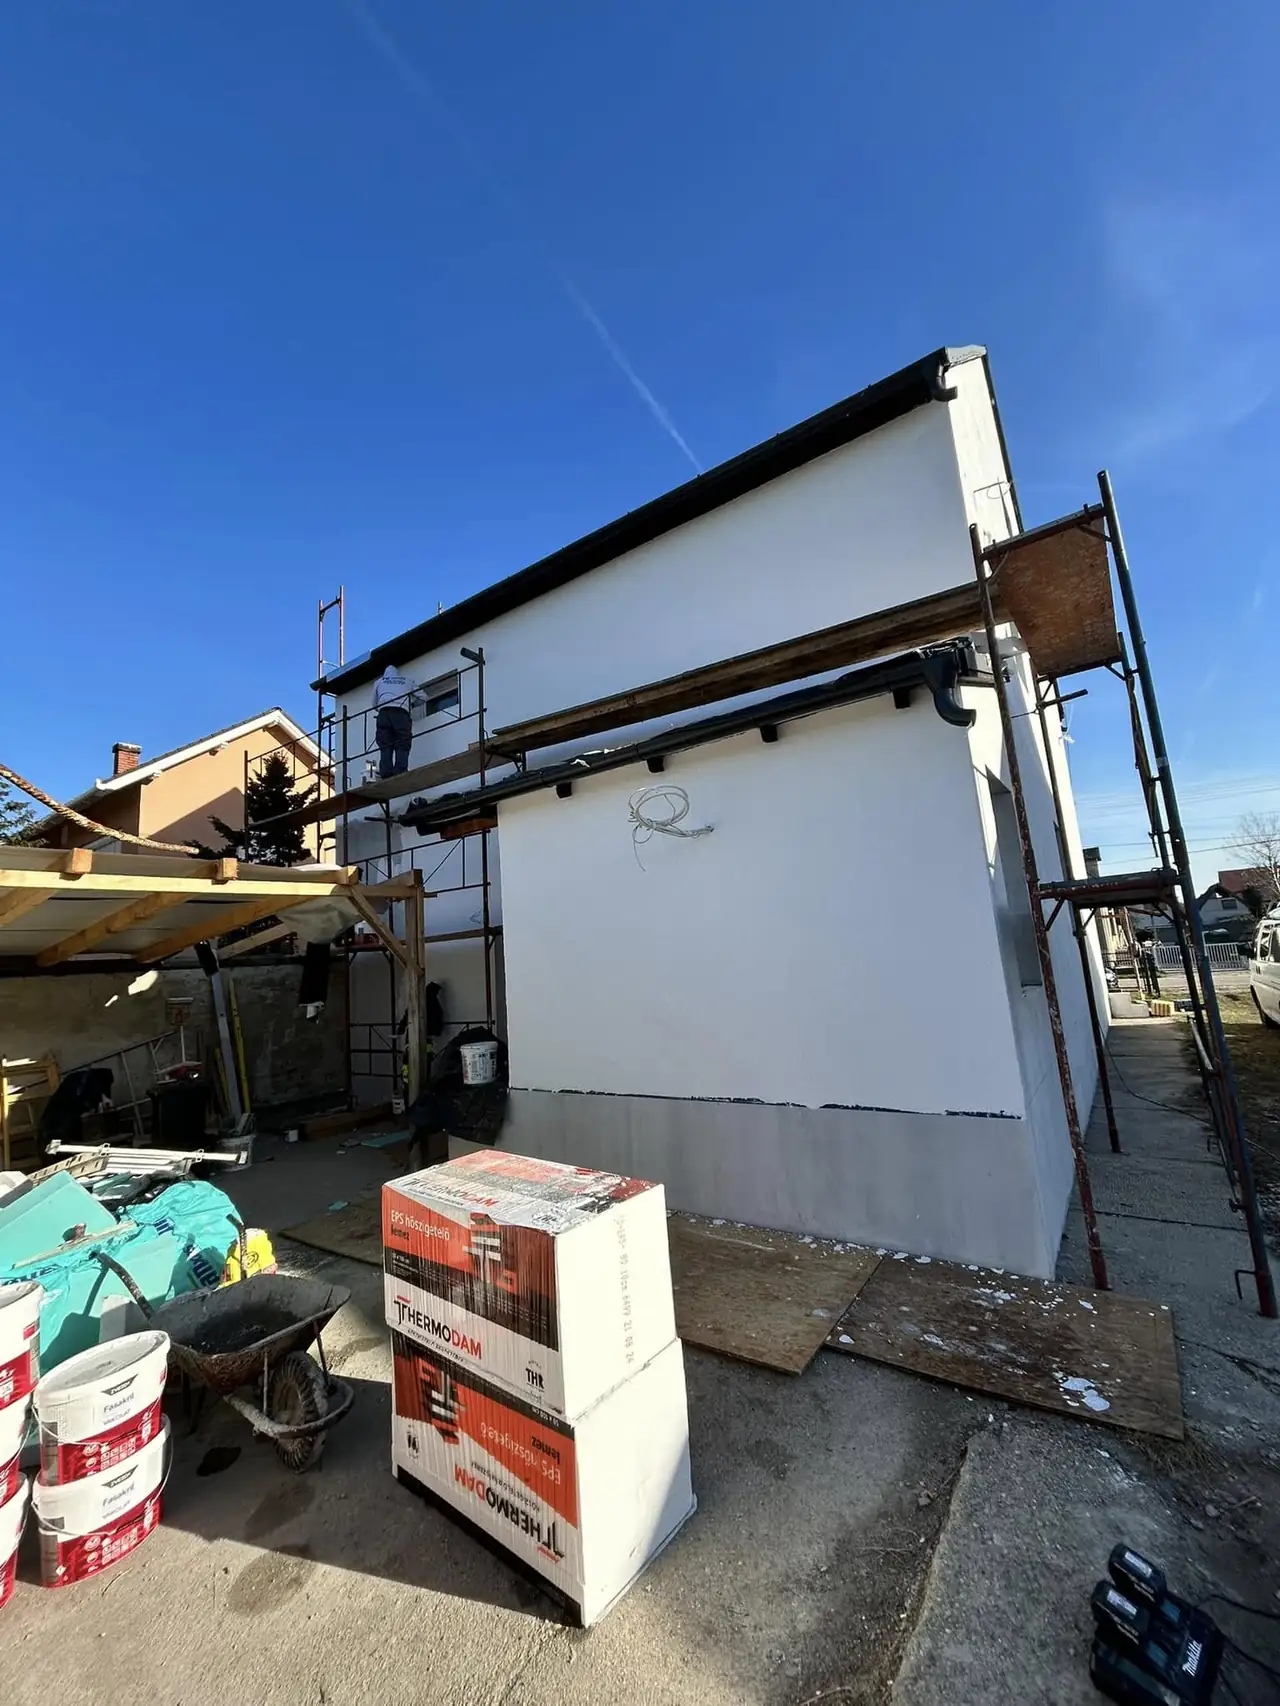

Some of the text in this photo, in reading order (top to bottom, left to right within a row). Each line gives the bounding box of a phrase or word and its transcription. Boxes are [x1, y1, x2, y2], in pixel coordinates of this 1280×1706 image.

[391, 1210, 404, 1225] EPS
[394, 1297, 482, 1361] THERMODAM
[525, 1367, 545, 1390] THR
[541, 1458, 561, 1485] EPS
[455, 1464, 565, 1561] THERMODAM
